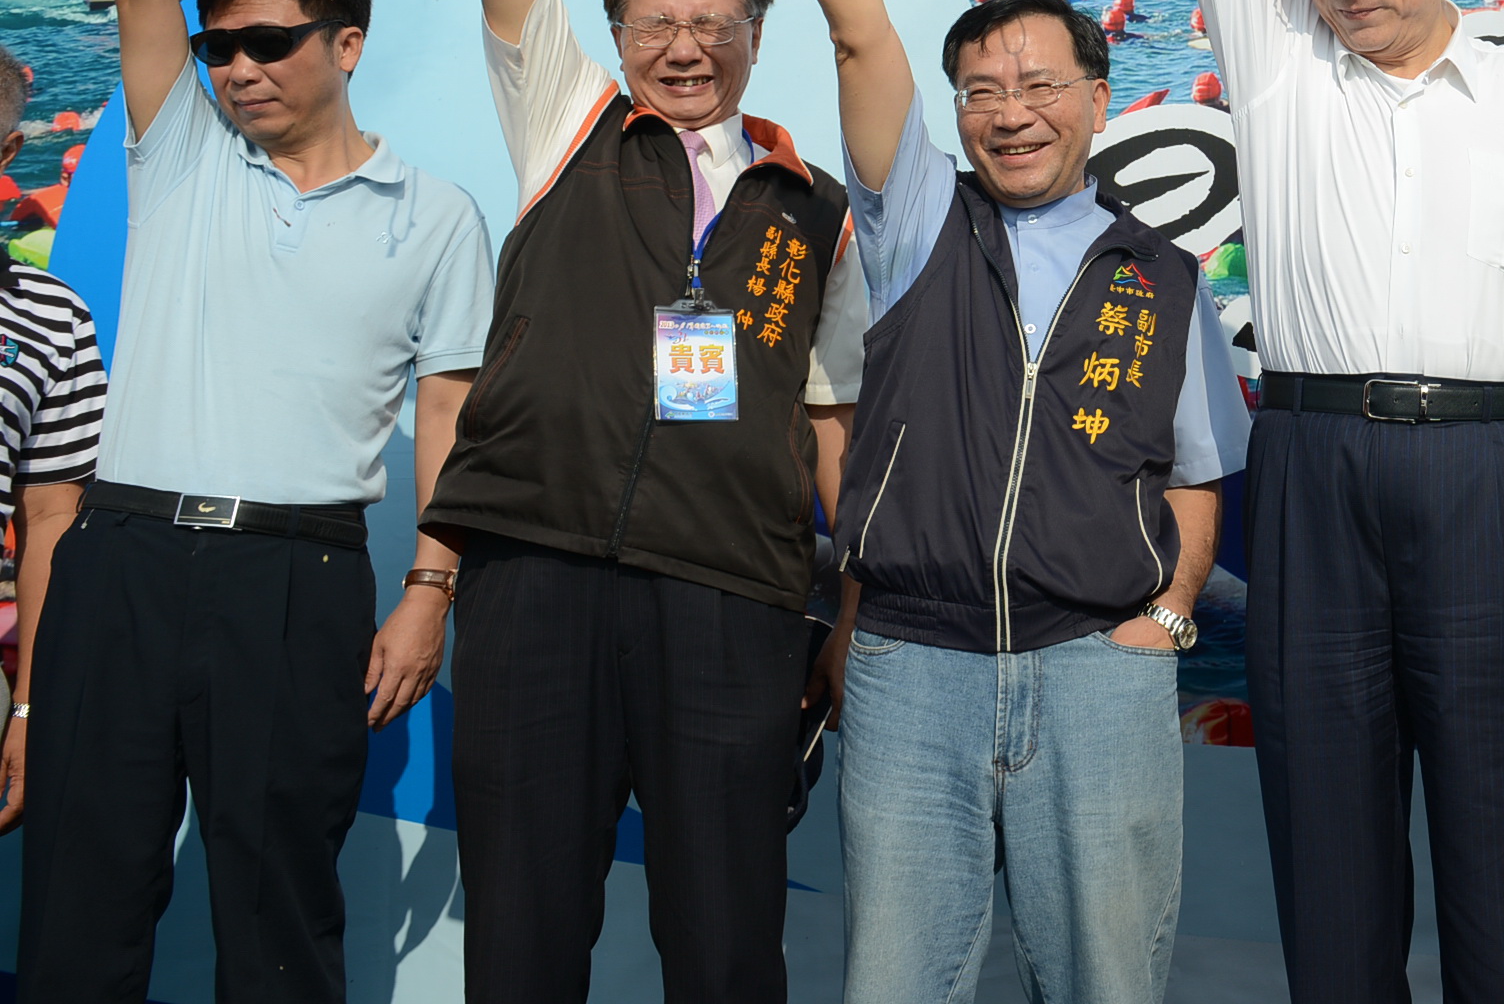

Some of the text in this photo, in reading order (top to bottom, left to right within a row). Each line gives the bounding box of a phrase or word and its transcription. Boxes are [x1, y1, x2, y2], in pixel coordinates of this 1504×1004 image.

[756, 238, 808, 348] 彰化縣政府
[669, 344, 725, 374] 貴賓
[1071, 301, 1133, 445] 蔡炳坤
[1126, 309, 1157, 389] 副市長
